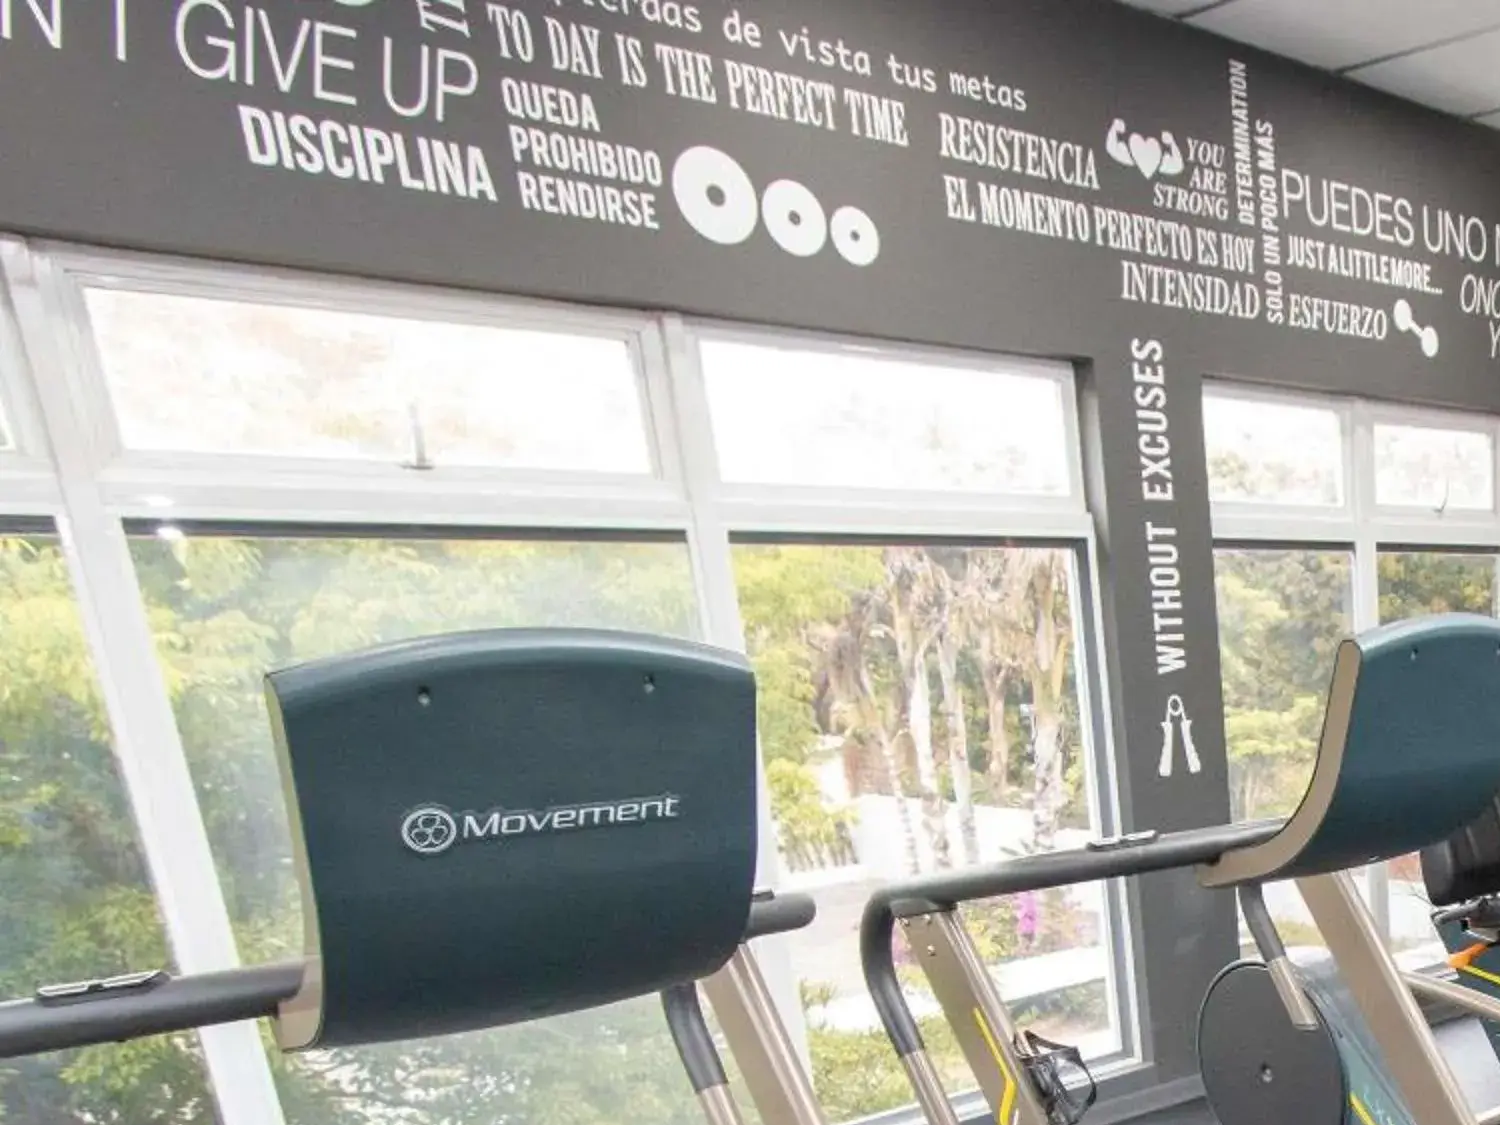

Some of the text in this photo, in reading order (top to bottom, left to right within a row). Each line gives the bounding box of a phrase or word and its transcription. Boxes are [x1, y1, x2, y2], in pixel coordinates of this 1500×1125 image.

[175, 0, 357, 105] GIVE
[382, 37, 479, 121] UP
[487, 4, 534, 63] TO
[543, 16, 603, 79] DAY
[614, 32, 647, 88] IS
[654, 43, 717, 104] THE
[724, 60, 836, 130] PERFECT
[844, 89, 909, 147] TIME
[723, 10, 762, 48] de
[779, 28, 871, 76] vista
[888, 54, 937, 92] tus
[949, 72, 1027, 112] metas
[502, 77, 600, 132] QUEDA
[239, 104, 497, 202] DISCIPLINA
[508, 124, 662, 187] PROHIBIDO
[938, 113, 1100, 189] RESISTENCIA
[1186, 136, 1225, 168] YOU
[1228, 58, 1255, 226] DETERMINATION
[517, 171, 660, 229] RENDIRSE
[1153, 183, 1229, 220] STRONG
[1189, 165, 1227, 195] ARE
[1258, 173, 1281, 233] POCO
[943, 174, 1256, 275] EL MOMENTO PERFECTO ES HOY
[1281, 168, 1414, 247] PUEDES
[1423, 205, 1487, 262] UNO
[1262, 235, 1281, 265] UN
[1287, 235, 1325, 271] JUST
[1121, 260, 1260, 319] INTENSIDAD
[1264, 270, 1284, 324] SOLO
[1289, 294, 1387, 340] ESFUERZO
[1131, 337, 1187, 675] WITHOUT EXCUSES
[463, 797, 681, 839] Movement
